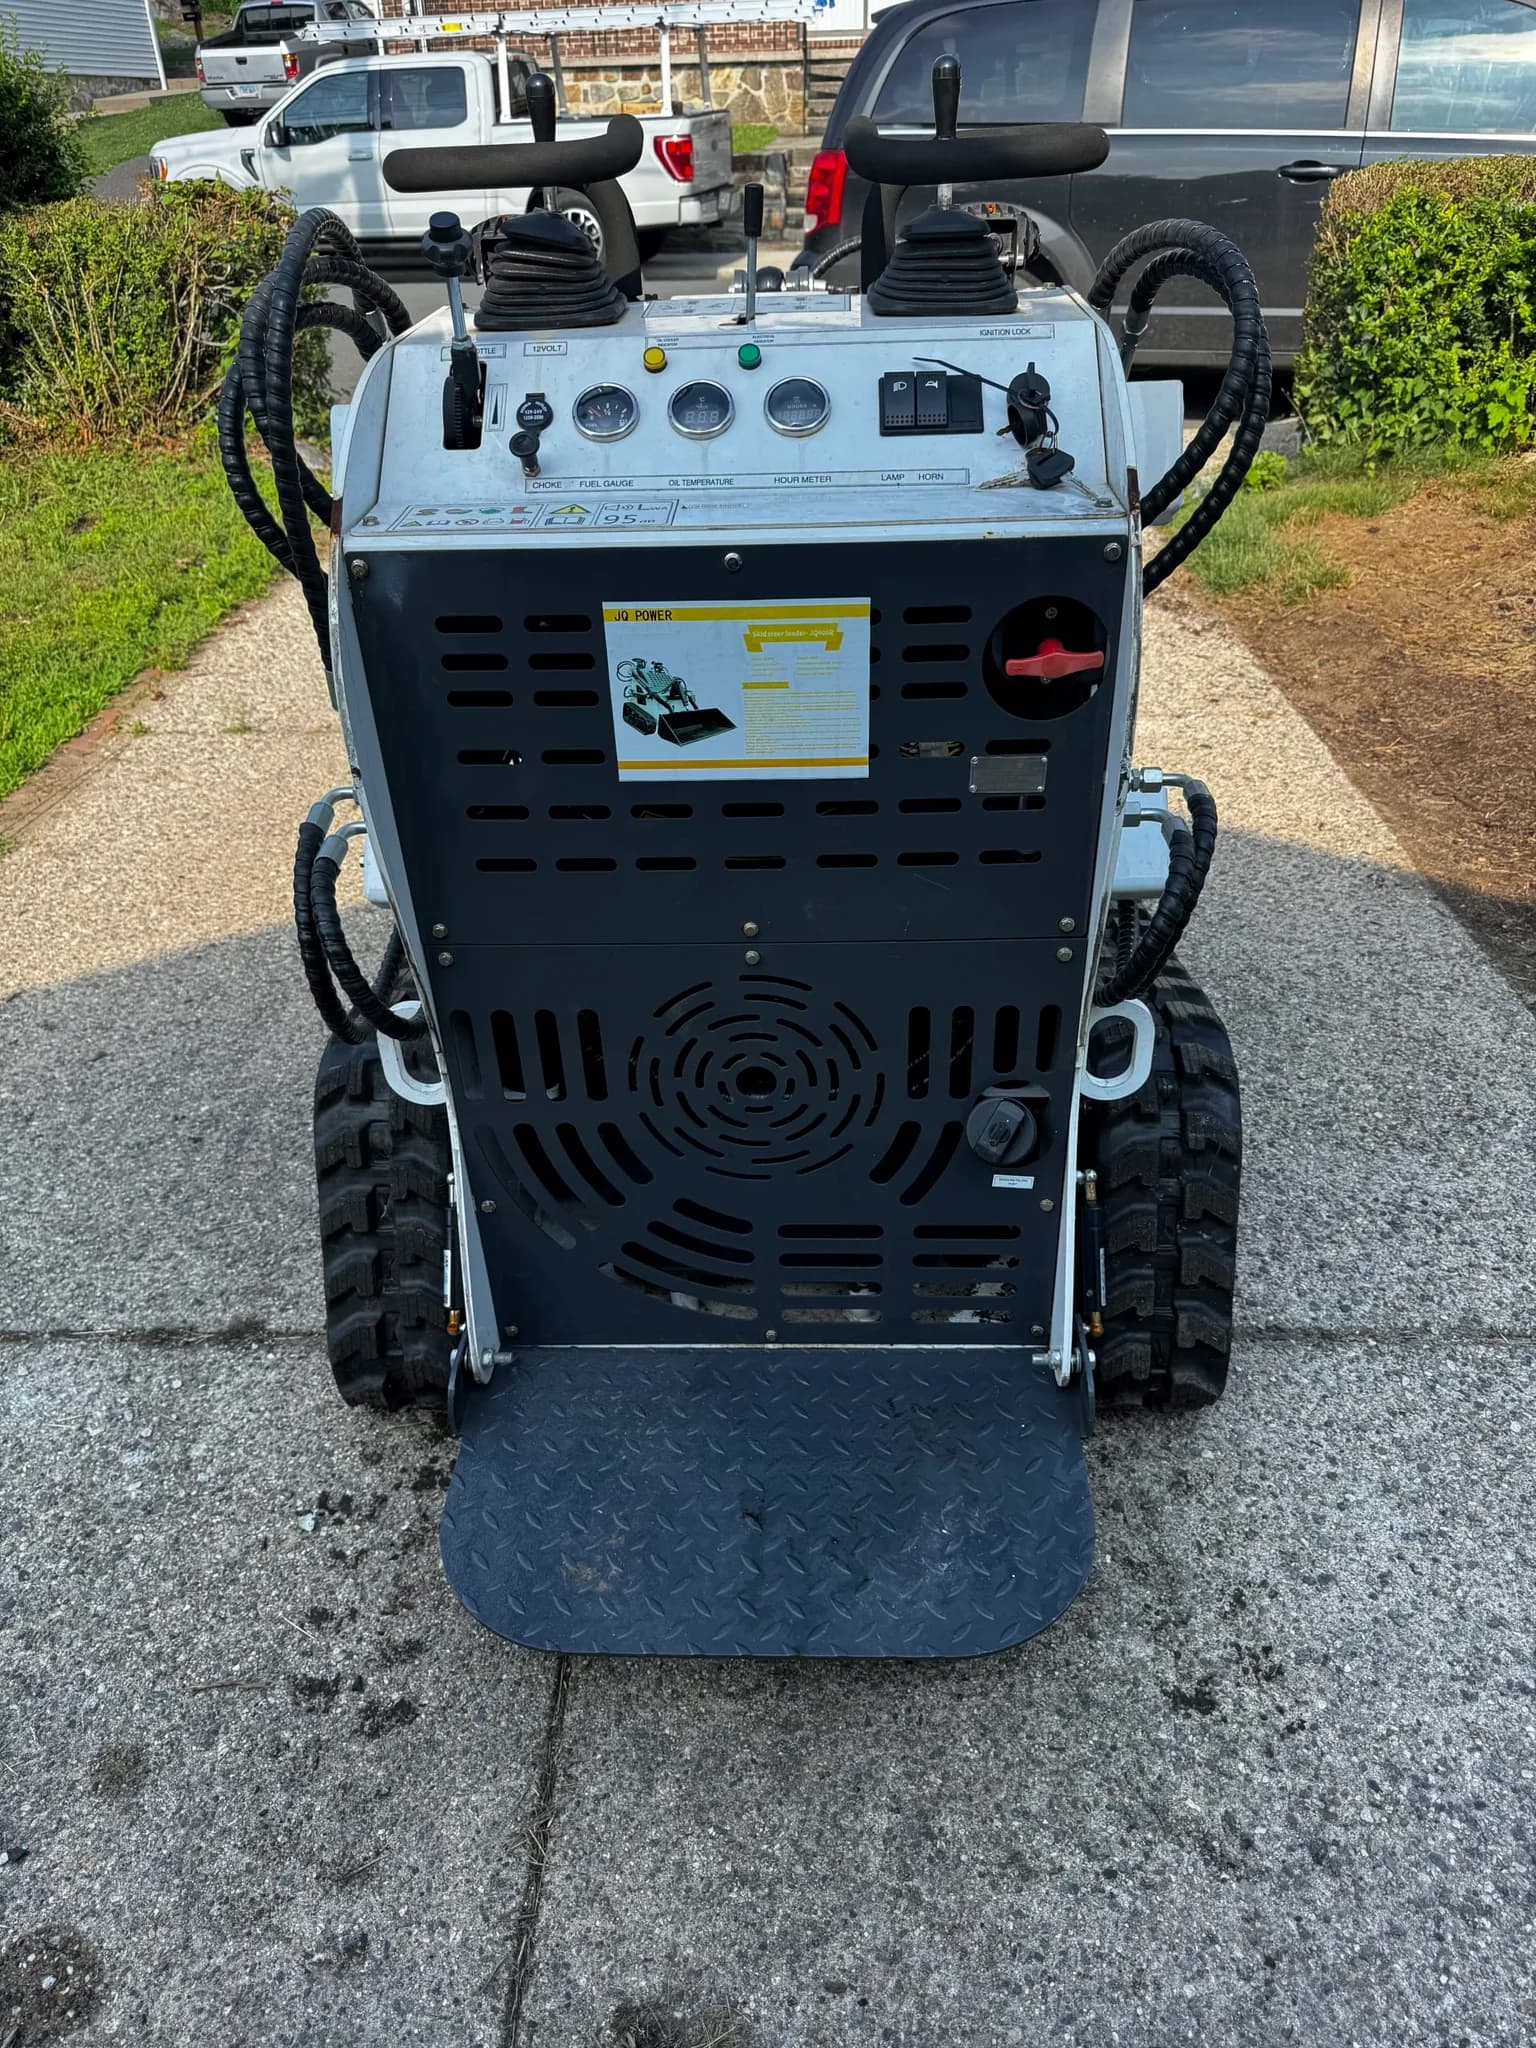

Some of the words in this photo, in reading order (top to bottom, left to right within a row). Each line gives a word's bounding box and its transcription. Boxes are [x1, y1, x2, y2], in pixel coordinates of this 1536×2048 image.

[980, 328, 1010, 336] IGNITION
[1011, 327, 1032, 335] LOCK
[533, 344, 562, 353] 12VOLT
[532, 481, 562, 489] CHOKE
[580, 480, 602, 488] FUEL
[603, 479, 634, 487] GAUGE
[668, 479, 680, 487] OIL
[681, 478, 735, 487] TEMPERATURE
[774, 476, 800, 484] HOUR
[801, 475, 832, 484] METER
[881, 473, 905, 482] LAMP
[918, 472, 944, 481] HORN
[603, 514, 637, 524] 95
[614, 610, 629, 622] JQ
[635, 609, 673, 622] POWER
